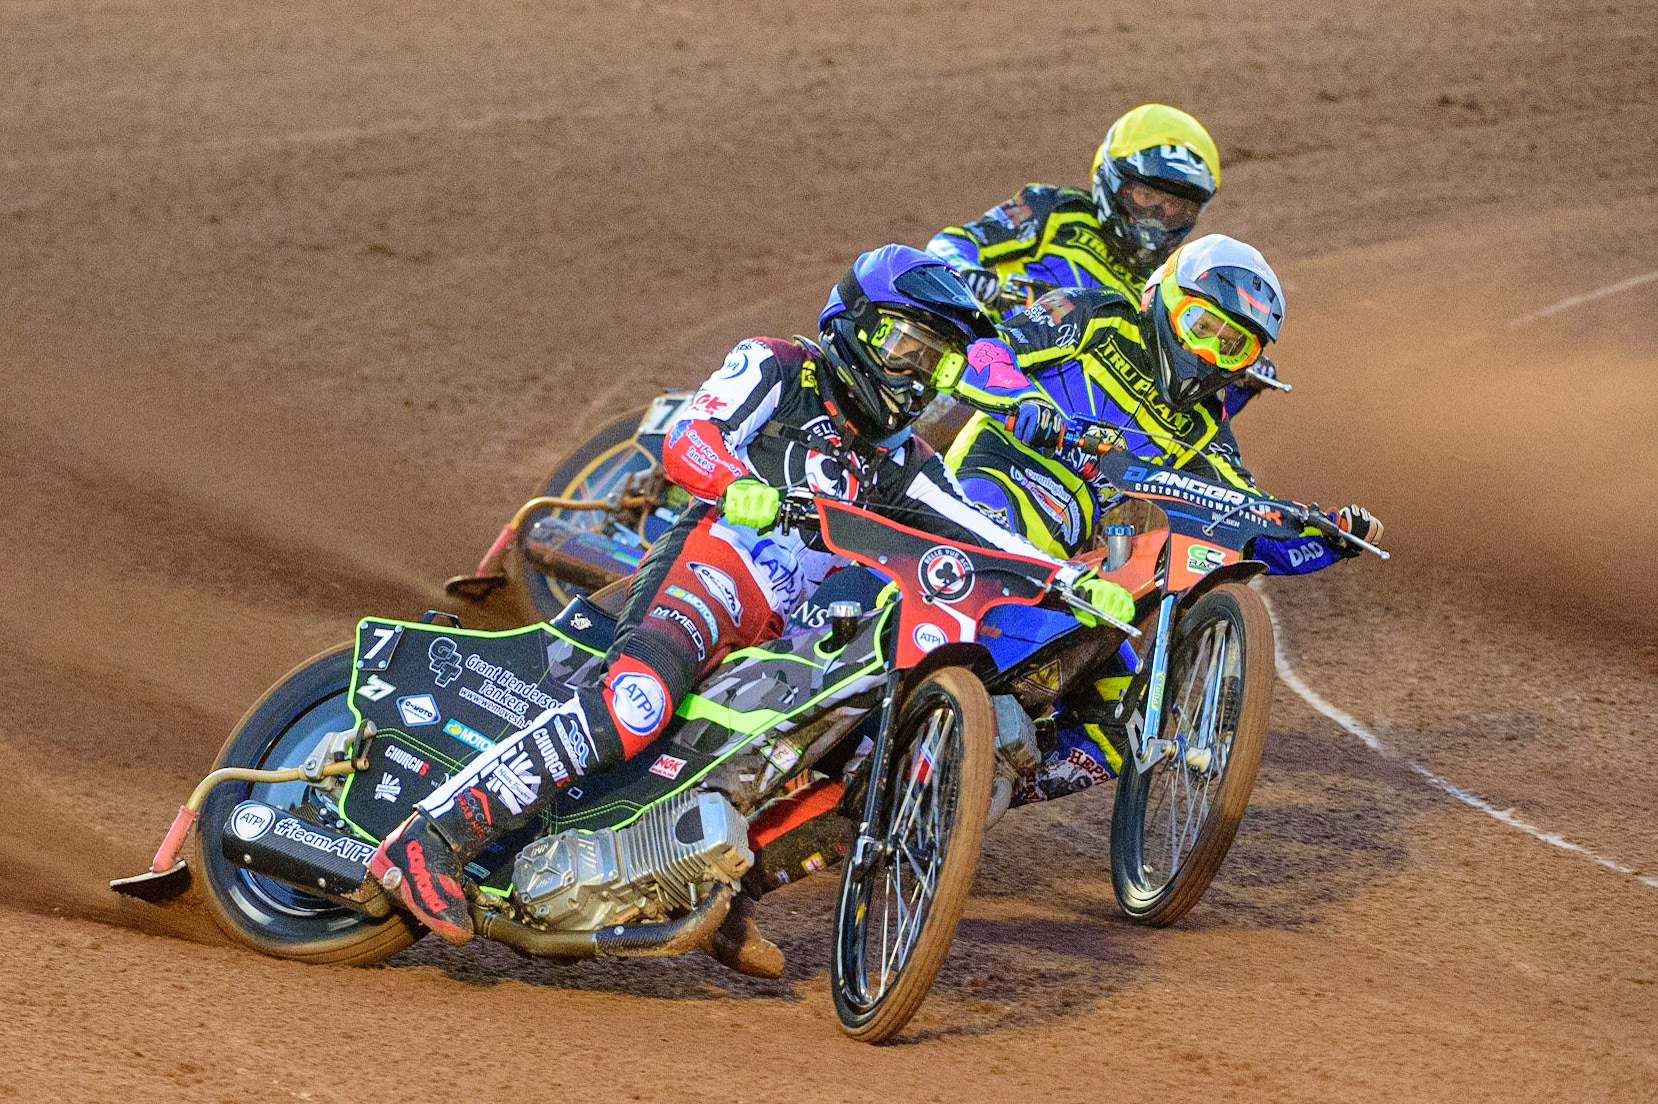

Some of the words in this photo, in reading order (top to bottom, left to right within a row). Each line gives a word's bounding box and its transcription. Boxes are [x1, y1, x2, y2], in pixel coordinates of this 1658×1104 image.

[1103, 343, 1138, 382] TRU
[686, 445, 716, 473] Tankers
[1123, 466, 1246, 507] DANGER
[1135, 482, 1180, 498] CUSTOM
[1239, 509, 1268, 528] PARTS
[923, 549, 942, 565] BELLE
[945, 549, 960, 559] VUE
[960, 558, 971, 571] ACE
[1287, 541, 1324, 568] DAD
[363, 627, 395, 660] 7
[919, 632, 941, 646] ATPI
[465, 653, 502, 681] Grant
[478, 679, 529, 715] Tankers
[621, 682, 656, 721] ATPI
[384, 744, 430, 777] CHURCHS
[656, 756, 684, 772] NGK
[239, 812, 266, 829] ATPI
[274, 817, 378, 865] #teamATPI
